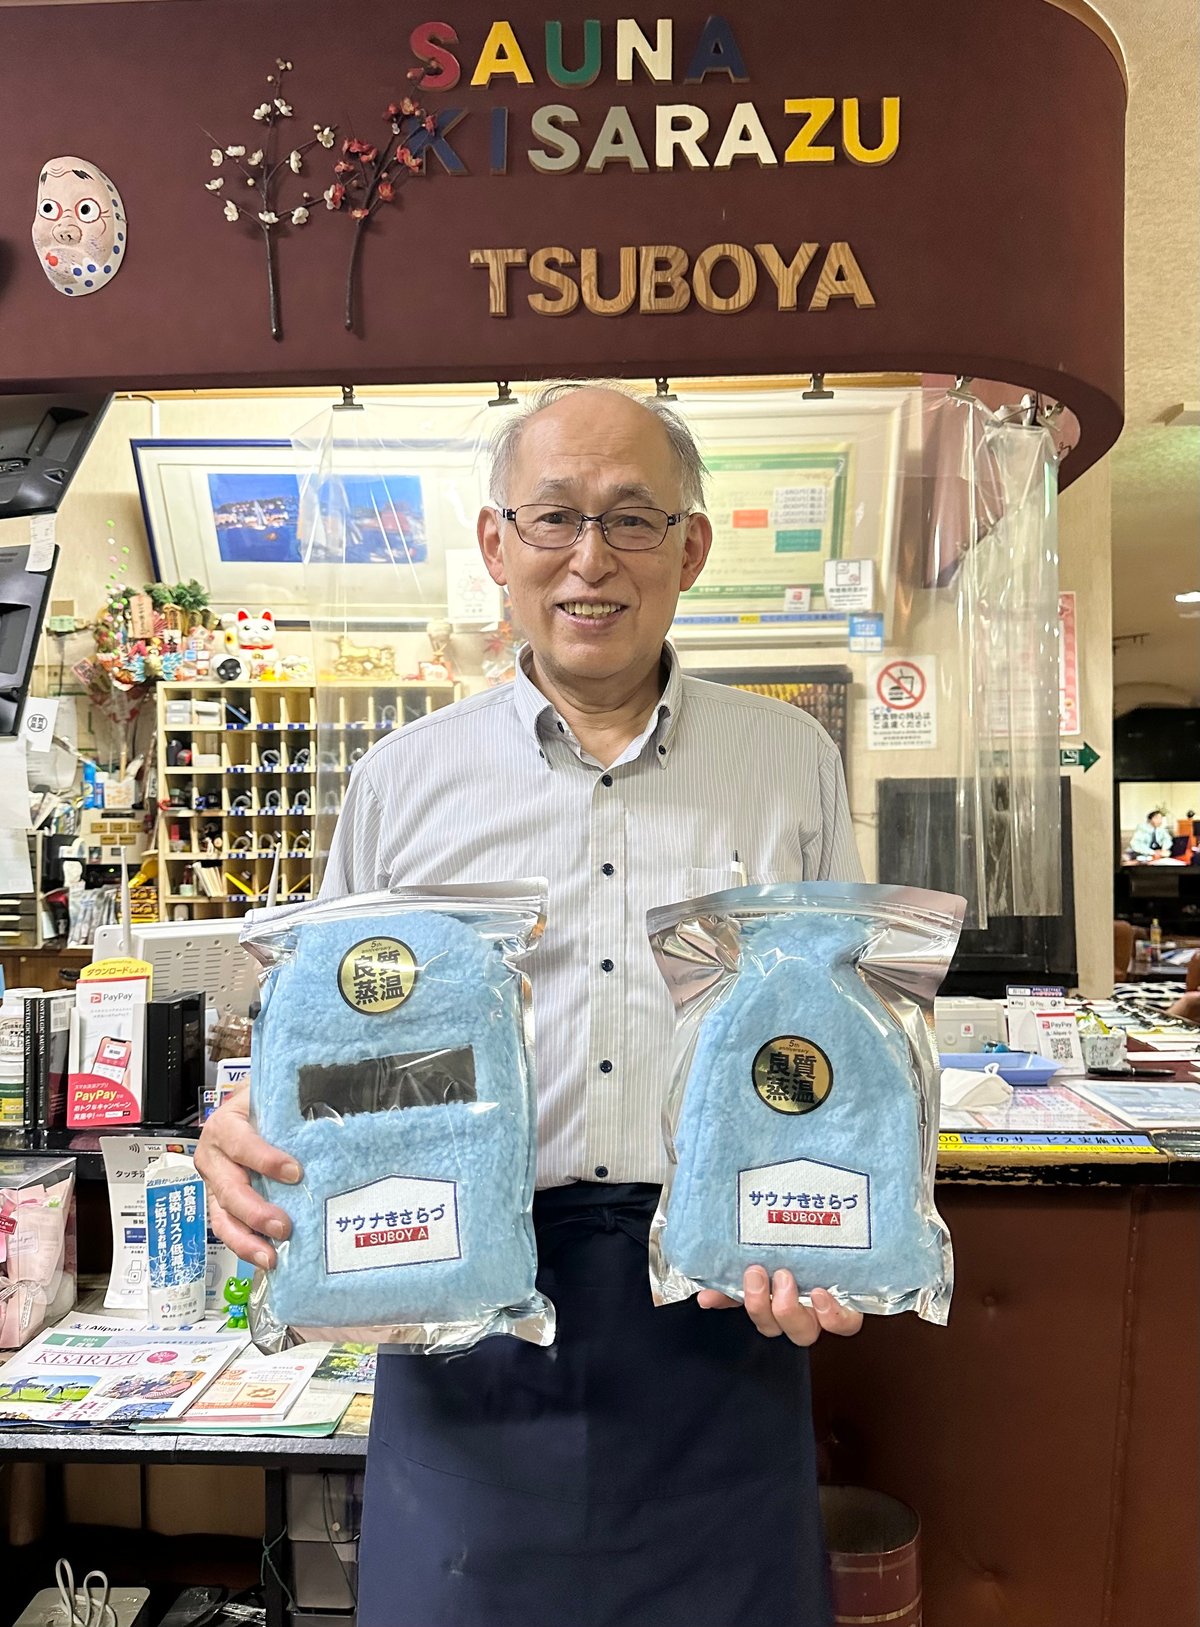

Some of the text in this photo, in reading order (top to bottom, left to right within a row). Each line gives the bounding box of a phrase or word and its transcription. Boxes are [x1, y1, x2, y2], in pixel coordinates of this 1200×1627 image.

[409, 15, 750, 90] SAUNA
[404, 97, 900, 176] KISARAZU
[469, 242, 876, 317] TSUBOYA
[103, 993, 133, 1001] PayPay
[228, 1071, 247, 1082] VIS
[767, 1052, 817, 1080] 良質
[74, 1090, 117, 1103] PayPay
[183, 1184, 197, 1223] 飲食店の
[749, 1190, 859, 1210] サウナきさらづ
[336, 1203, 445, 1232] サウナきさらづ
[34, 1352, 144, 1366] KISARAZU
